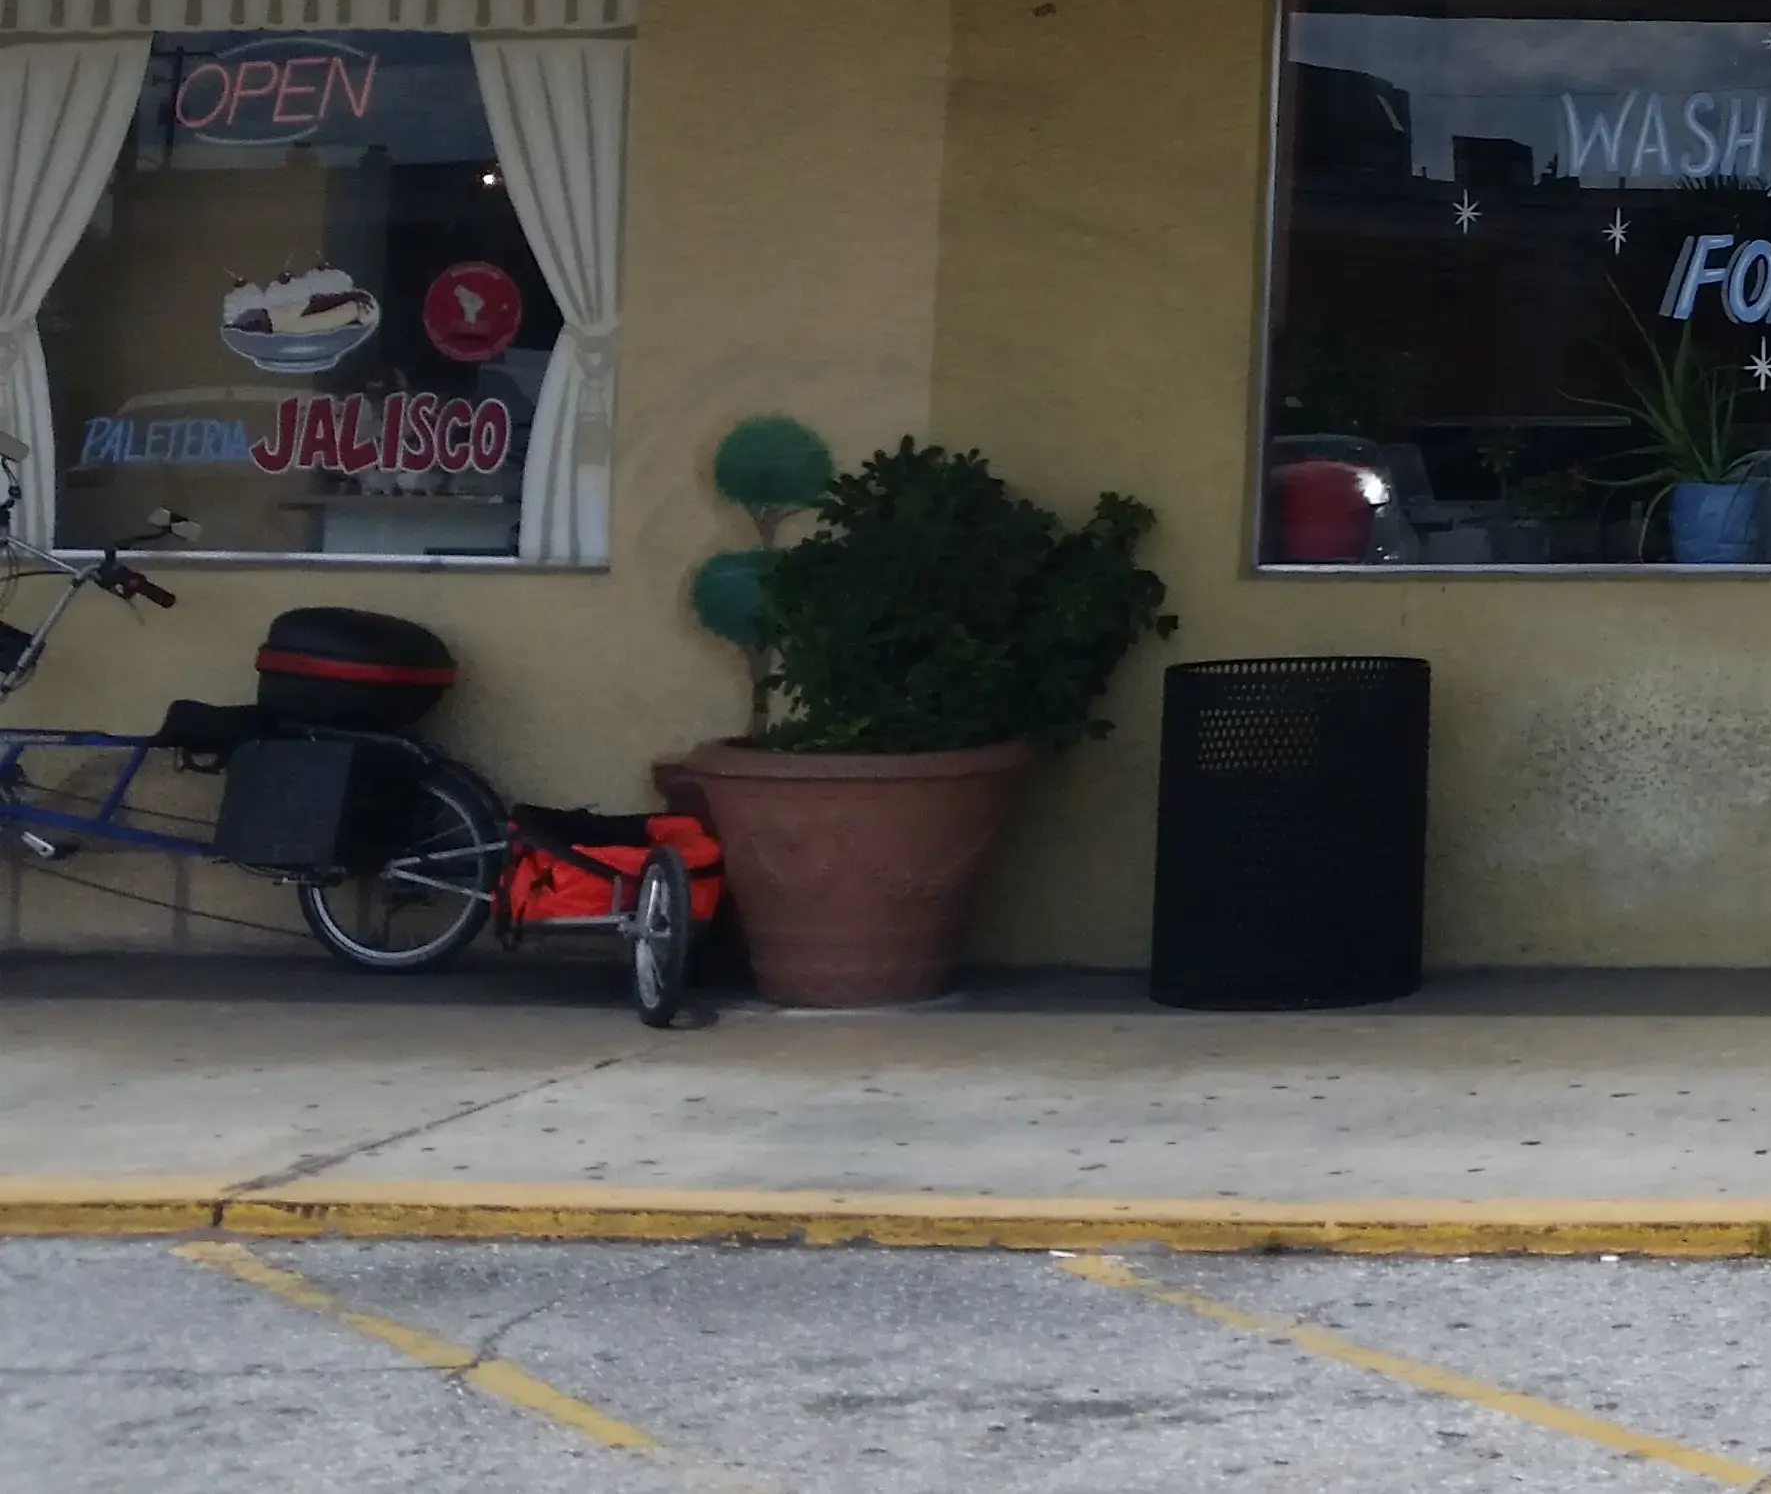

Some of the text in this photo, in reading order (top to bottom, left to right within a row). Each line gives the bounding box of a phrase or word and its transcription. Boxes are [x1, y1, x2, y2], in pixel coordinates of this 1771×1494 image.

[176, 54, 378, 128] OPEN
[81, 392, 511, 475] PALETERIA JALISCO
